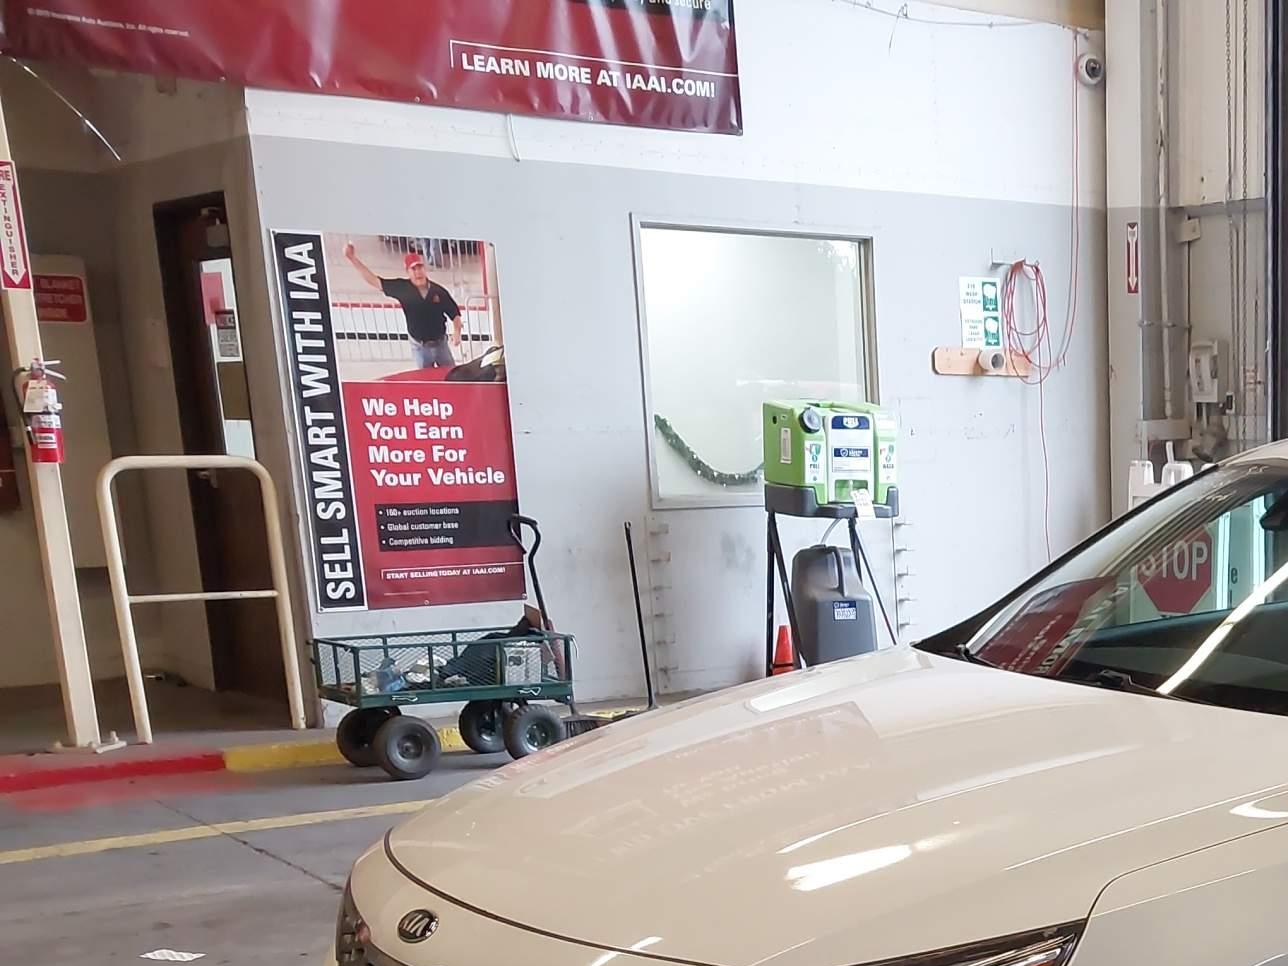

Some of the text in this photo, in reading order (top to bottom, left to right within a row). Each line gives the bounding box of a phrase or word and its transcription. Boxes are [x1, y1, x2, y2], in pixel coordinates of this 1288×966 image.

[462, 53, 715, 98] LEARN MORE AT IAAI.COM!
[362, 398, 453, 420] We Help
[284, 242, 356, 600] SELL SMART WITH IAA
[365, 422, 463, 440] You Earn
[368, 445, 467, 463] More For
[370, 467, 505, 487] Your Vehicle
[403, 508, 428, 516] auction
[429, 506, 459, 515] locations
[387, 521, 459, 531] Global customer base
[389, 536, 453, 546] Competitive bidding
[1141, 540, 1208, 581] STOP
[386, 567, 506, 580] START SELLING TODAY AT IAAI.COM!
